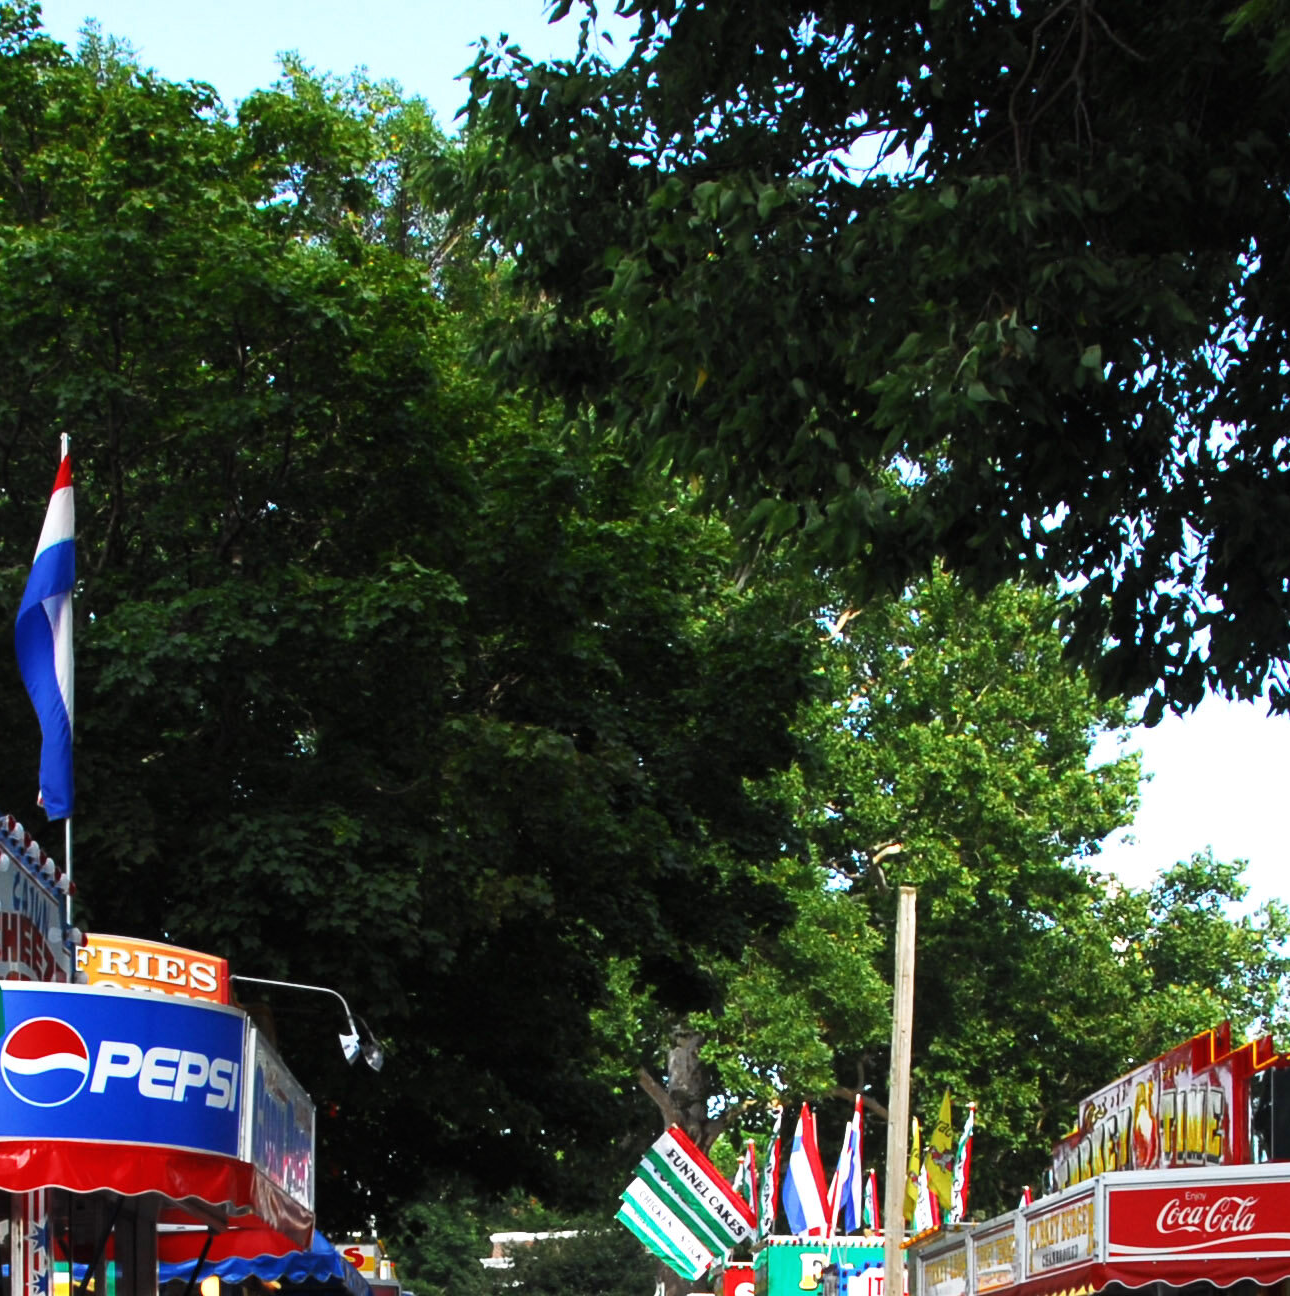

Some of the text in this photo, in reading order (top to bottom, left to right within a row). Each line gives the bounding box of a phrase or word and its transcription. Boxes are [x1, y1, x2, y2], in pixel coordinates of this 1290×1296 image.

[75, 945, 217, 993] FRIES
[89, 1040, 239, 1112] PEPSI
[1160, 1089, 1225, 1165] TIME
[667, 1148, 710, 1198] FUNNEL
[709, 1195, 746, 1236] CAKES
[1156, 1196, 1260, 1234] Coca-Cola
[1184, 1191, 1207, 1202] Enjoy
